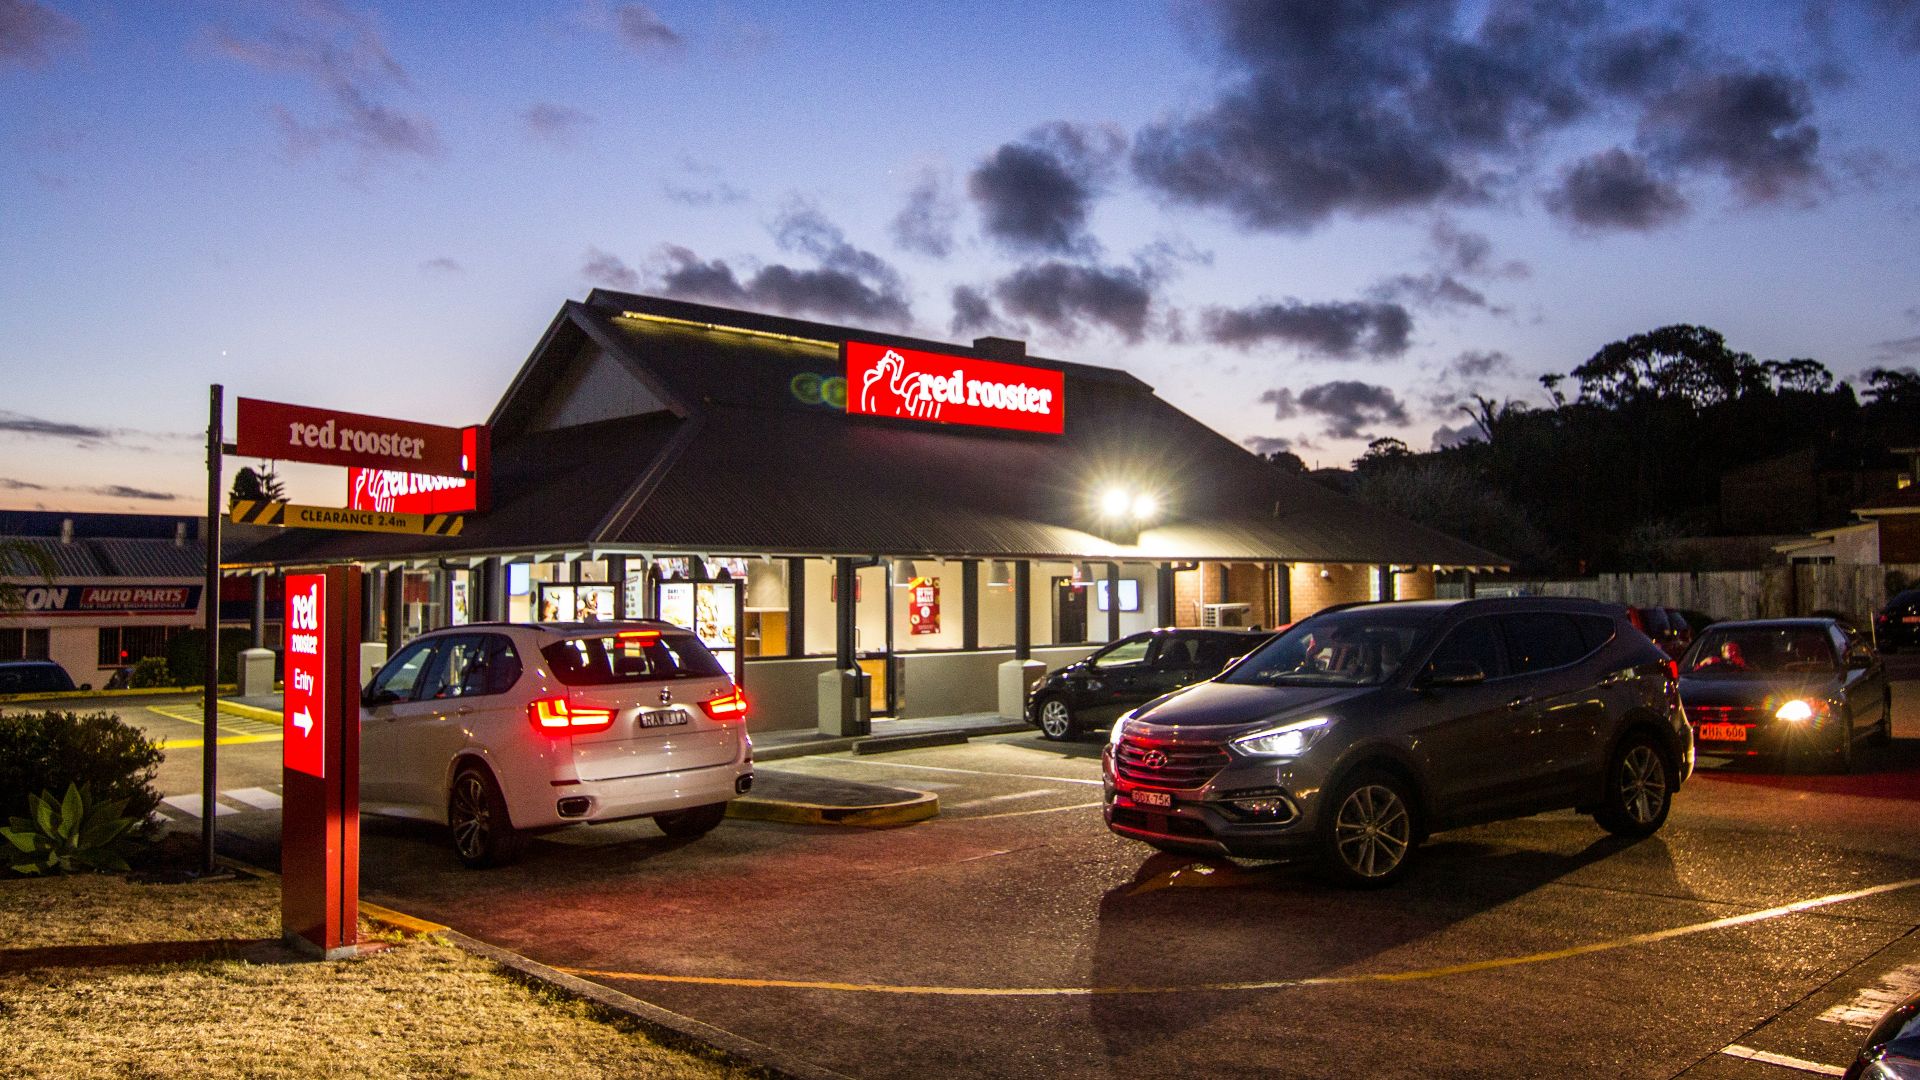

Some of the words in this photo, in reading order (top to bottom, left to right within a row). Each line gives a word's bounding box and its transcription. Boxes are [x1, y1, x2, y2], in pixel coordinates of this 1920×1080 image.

[918, 369, 965, 405] red
[966, 379, 1052, 415] rooster
[289, 419, 336, 450] red
[339, 428, 425, 460] rooster
[301, 510, 374, 526] CLEARANCE
[378, 516, 407, 528] 2.4m
[88, 588, 129, 603] AUTO
[132, 588, 182, 602] PARTS
[292, 583, 318, 630] red
[292, 633, 318, 655] rooster
[294, 667, 314, 697] Entry
